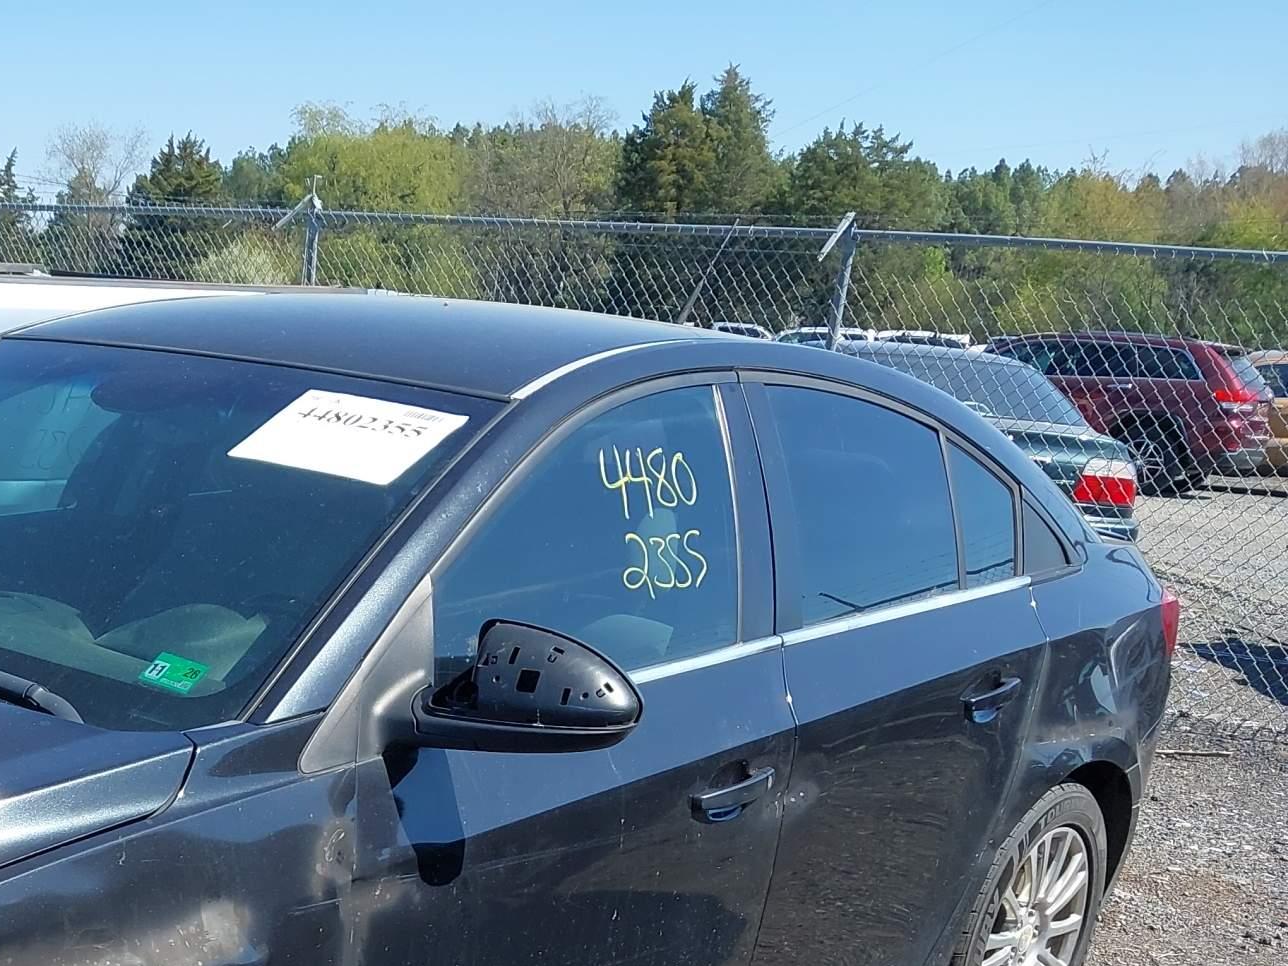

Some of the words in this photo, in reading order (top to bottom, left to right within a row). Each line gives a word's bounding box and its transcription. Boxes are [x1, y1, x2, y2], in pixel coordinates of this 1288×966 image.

[297, 405, 429, 439] 44802355
[598, 443, 698, 520] 4480
[622, 529, 709, 600] 2355
